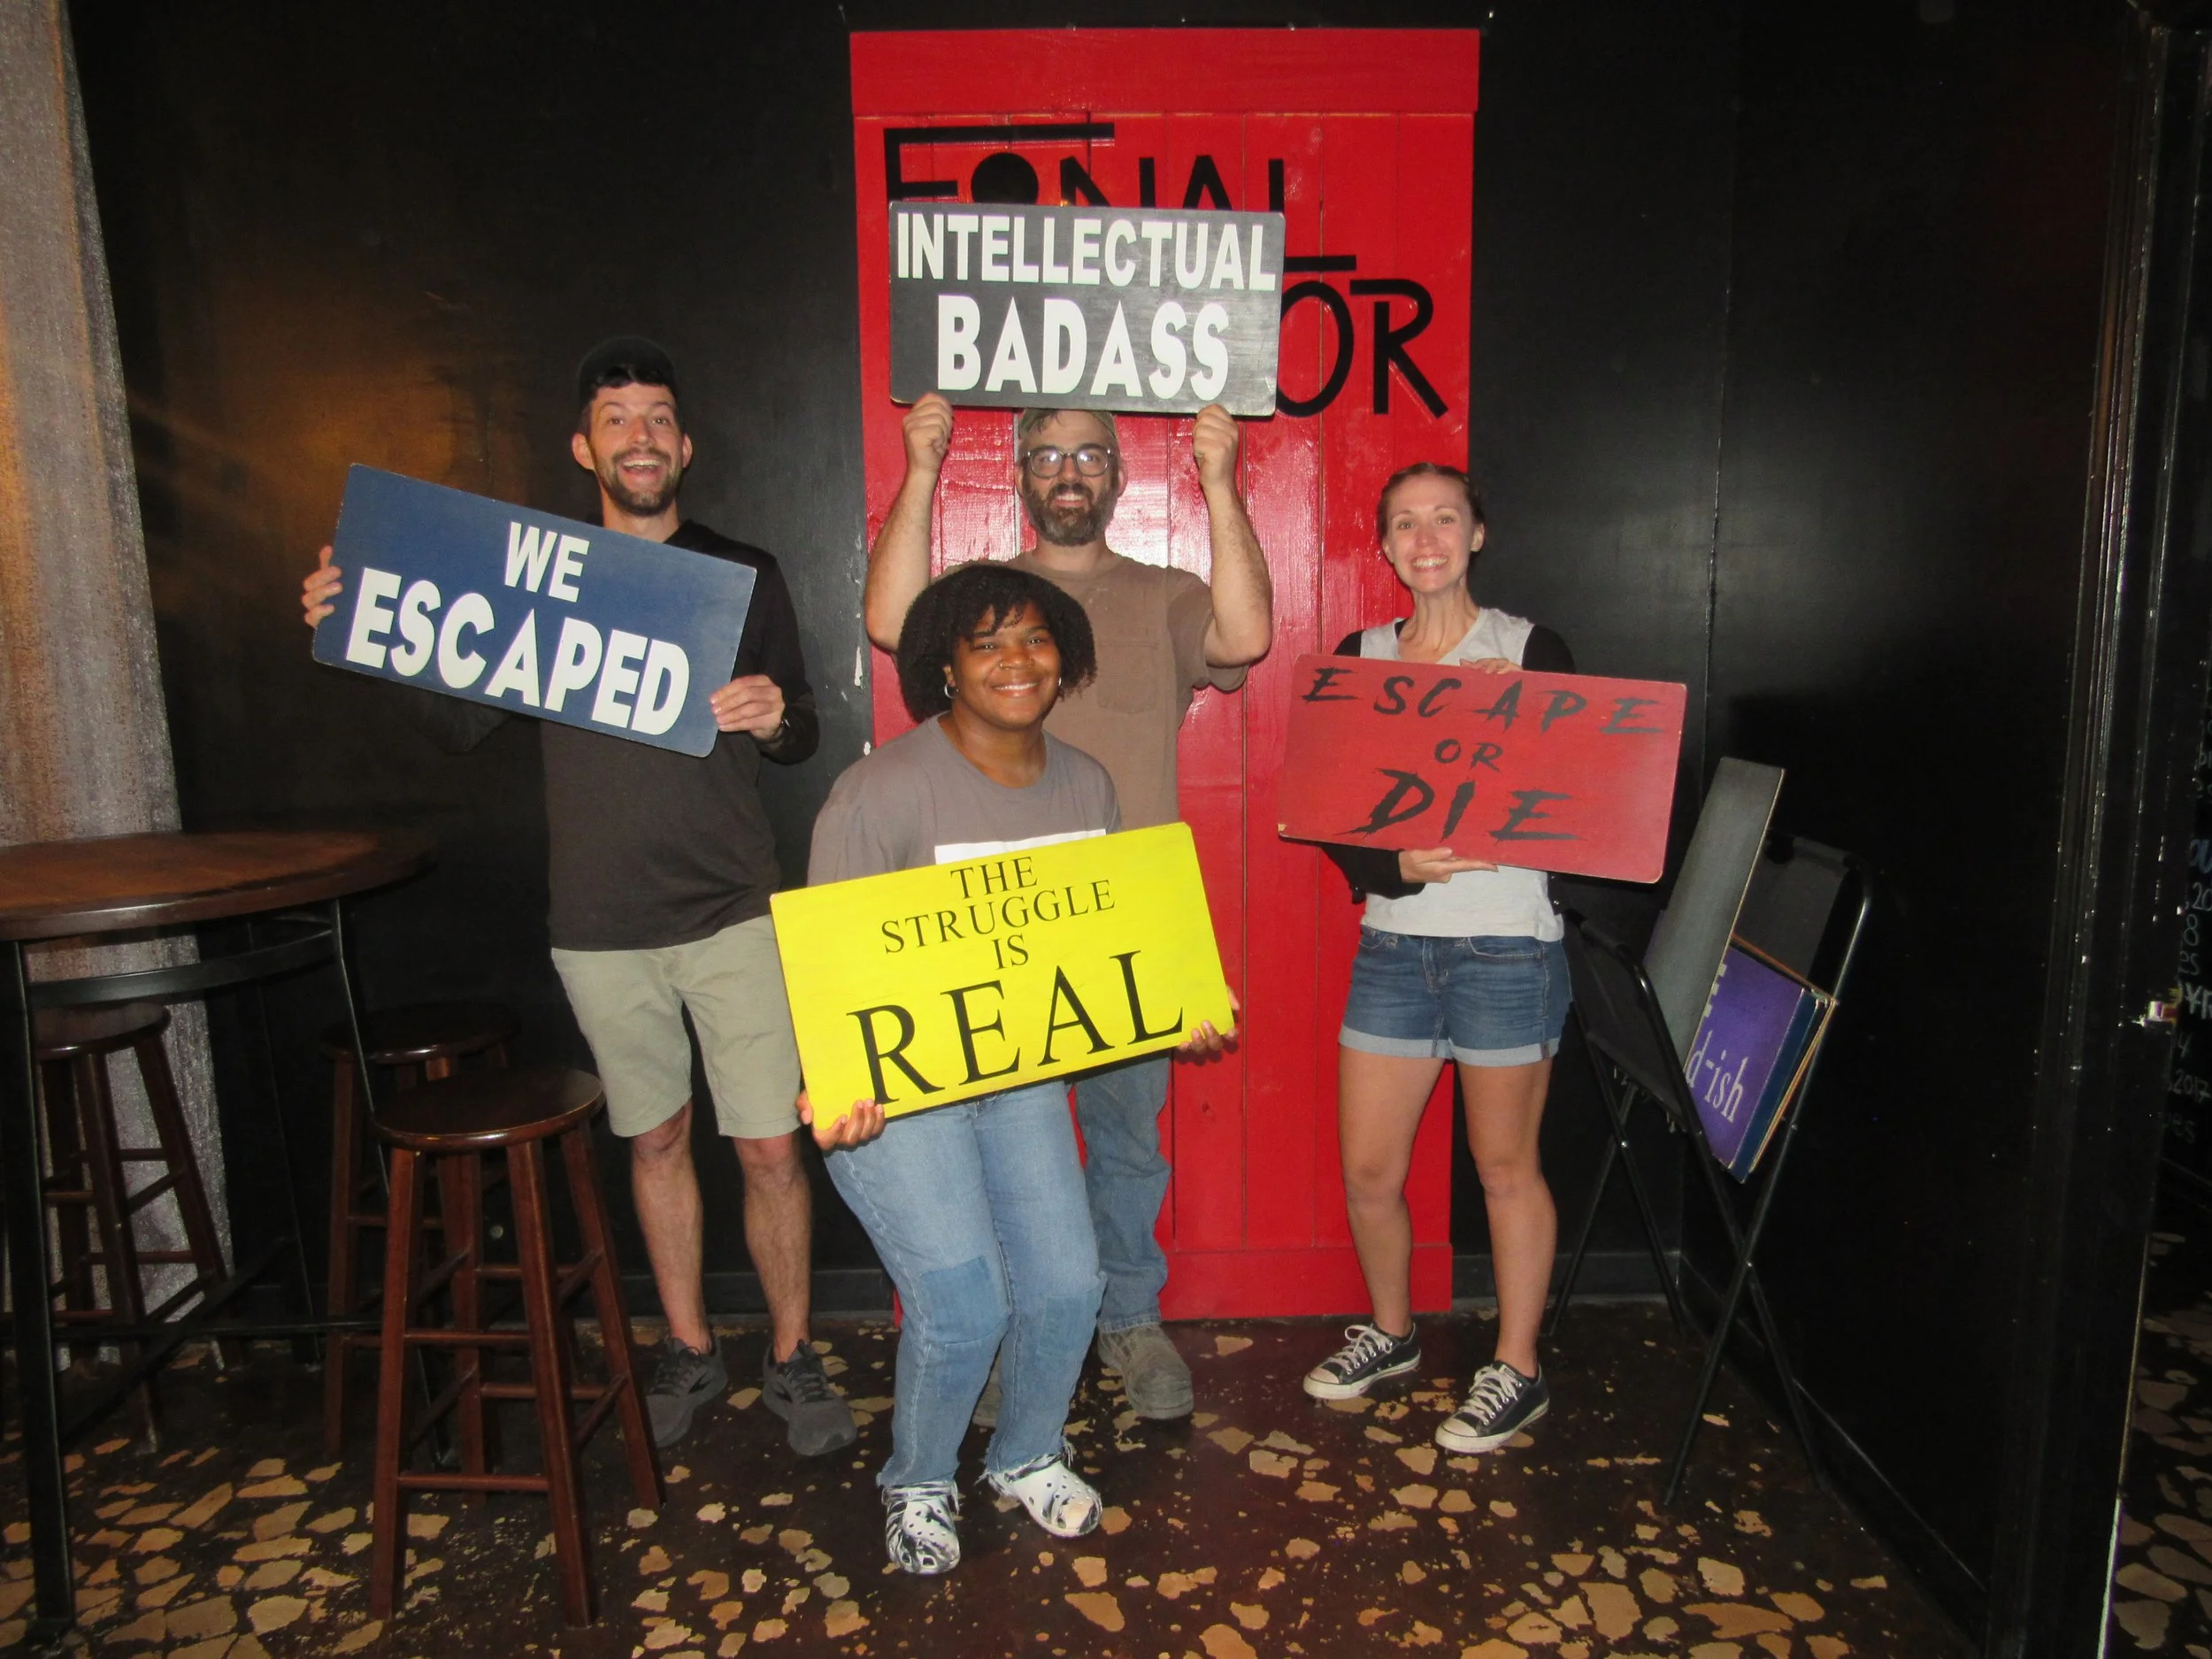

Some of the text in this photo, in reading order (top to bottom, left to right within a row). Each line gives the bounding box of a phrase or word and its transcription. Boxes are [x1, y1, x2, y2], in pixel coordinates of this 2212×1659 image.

[896, 212, 1276, 291] INTELLECTUAL
[937, 294, 1229, 401] BADASS
[503, 521, 590, 603] WE
[346, 566, 690, 736] ESCAPED
[1301, 665, 1665, 736] ESCAPE
[1433, 738, 1504, 772] OR
[1333, 767, 1586, 844] DIE
[949, 856, 1039, 900] THE
[880, 879, 1117, 955] STRUGGLE
[990, 933, 1029, 971] IS
[846, 949, 1184, 1105] REAL
